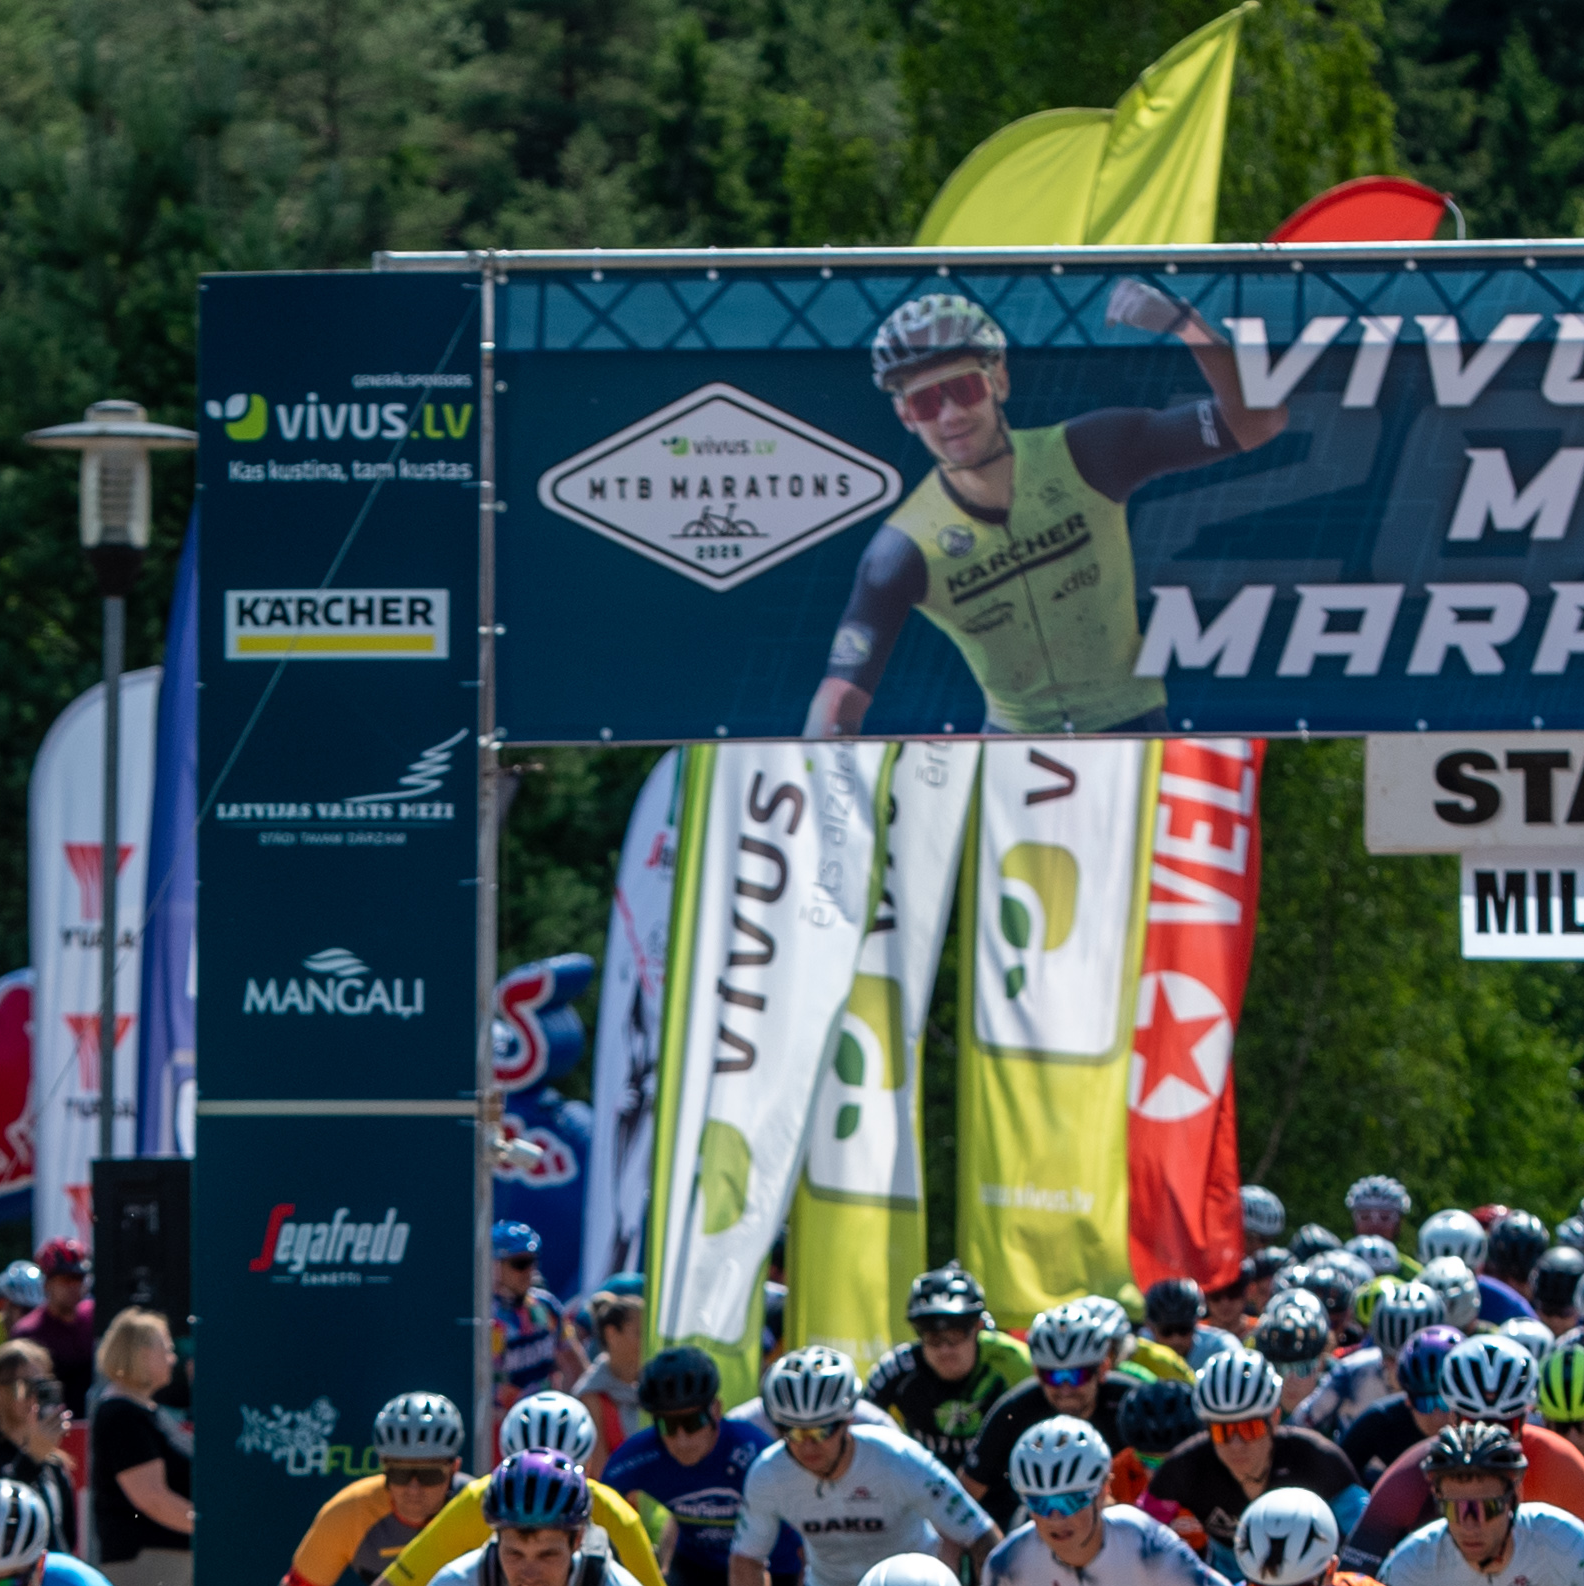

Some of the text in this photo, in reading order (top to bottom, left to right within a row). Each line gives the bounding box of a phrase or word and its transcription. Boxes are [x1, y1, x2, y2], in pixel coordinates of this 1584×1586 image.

[228, 460, 266, 482] Kas
[352, 460, 395, 480] tam
[399, 458, 473, 480] kustas
[589, 474, 851, 500] MTB MARATONS
[217, 803, 312, 820] LATVIJAS
[317, 803, 394, 820] VALSTS
[243, 978, 424, 1020] MANGAĻI
[249, 1203, 410, 1273] Segafredo
